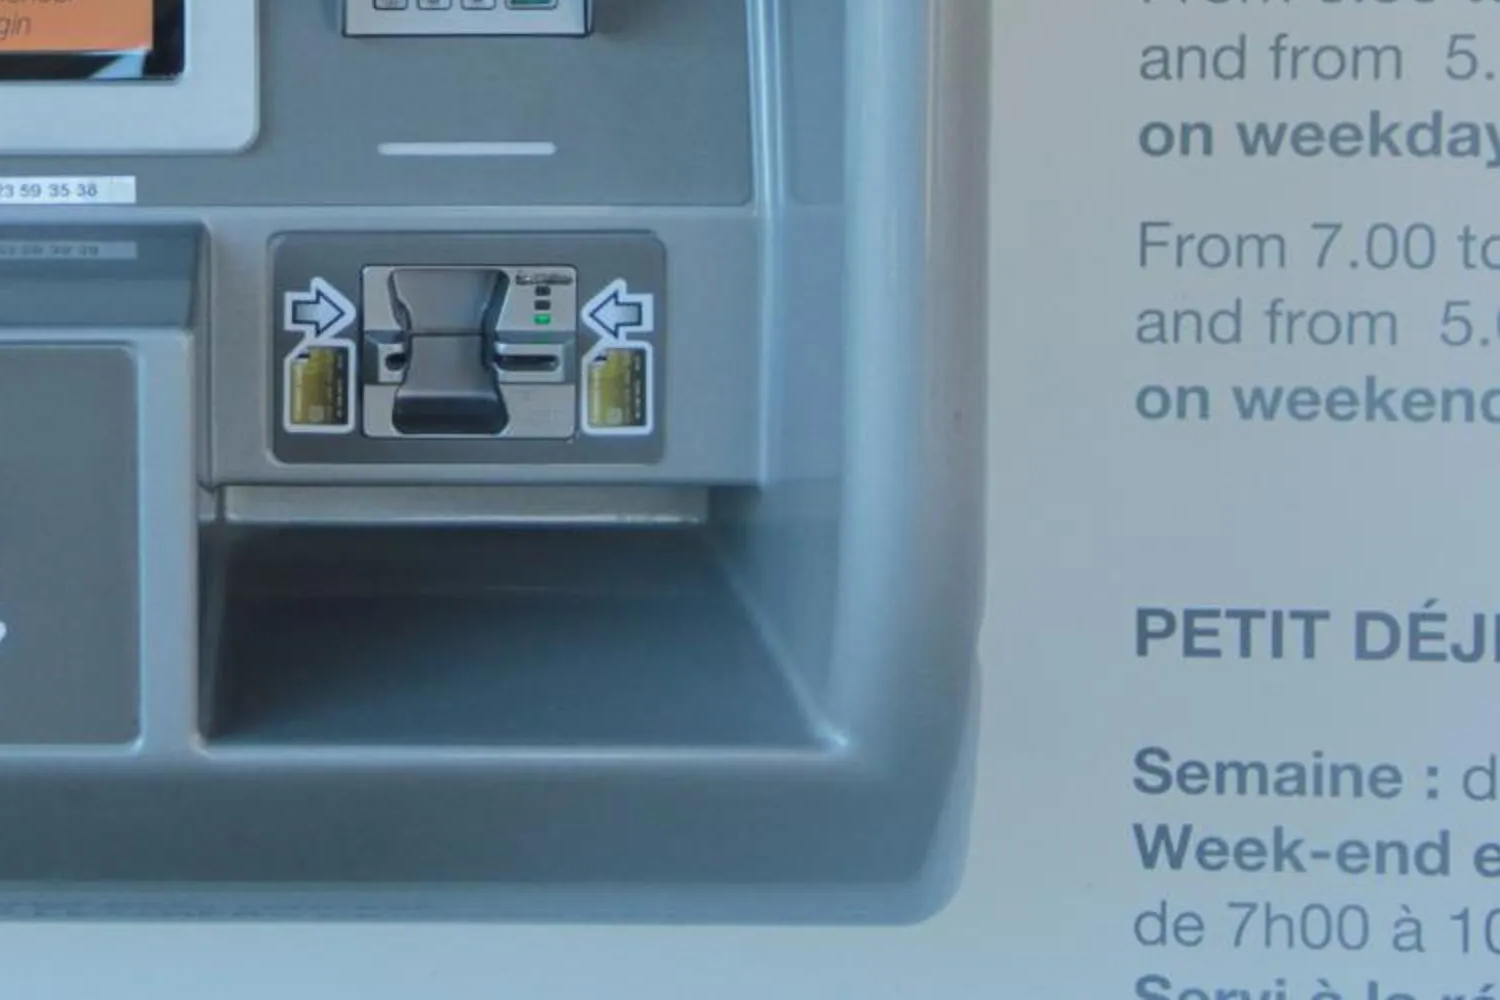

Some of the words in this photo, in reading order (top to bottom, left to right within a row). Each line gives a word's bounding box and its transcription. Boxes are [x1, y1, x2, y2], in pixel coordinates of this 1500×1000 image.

[1139, 32, 1247, 82] and
[1268, 32, 1403, 81] from
[1138, 121, 1214, 158] on
[19, 183, 42, 199] 59
[48, 183, 71, 199] 35
[1139, 220, 1286, 270] From
[1310, 221, 1437, 271] 7.00
[1456, 224, 1500, 271] to
[1135, 296, 1243, 345] and
[1263, 297, 1398, 346] from
[1439, 299, 1500, 348] 5.
[1135, 384, 1211, 421] on
[1135, 606, 1331, 660] PETIT
[1354, 597, 1500, 664] DÉJ
[1132, 745, 1403, 800] Semaine
[1426, 765, 1439, 800] :
[1131, 822, 1450, 877] Week-end
[1133, 898, 1205, 948] de
[1227, 900, 1370, 951] 7h00
[1391, 903, 1426, 954] à
